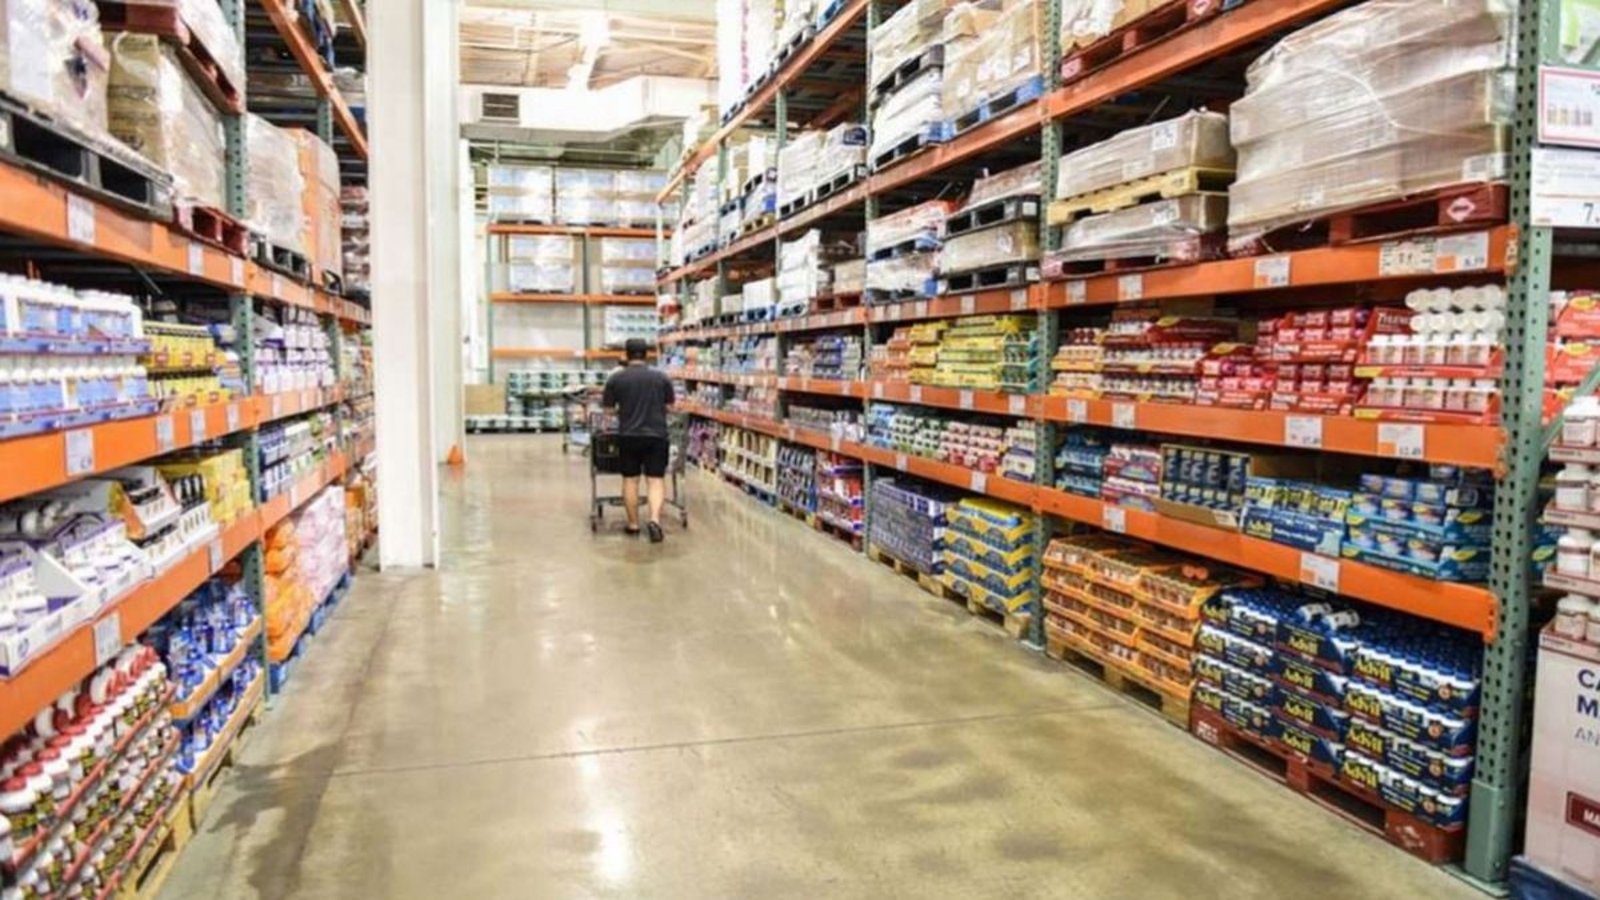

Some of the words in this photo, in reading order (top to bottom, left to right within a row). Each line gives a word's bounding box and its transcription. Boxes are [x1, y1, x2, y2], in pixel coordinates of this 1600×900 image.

[1284, 668, 1313, 689] Advil
[1354, 656, 1391, 683] Advil
[1578, 669, 1600, 693] C
[1284, 701, 1314, 722] Advil
[1346, 692, 1381, 718] Advil
[1577, 694, 1600, 718] M
[1346, 730, 1383, 755] Advil
[1342, 761, 1378, 787] Advil
